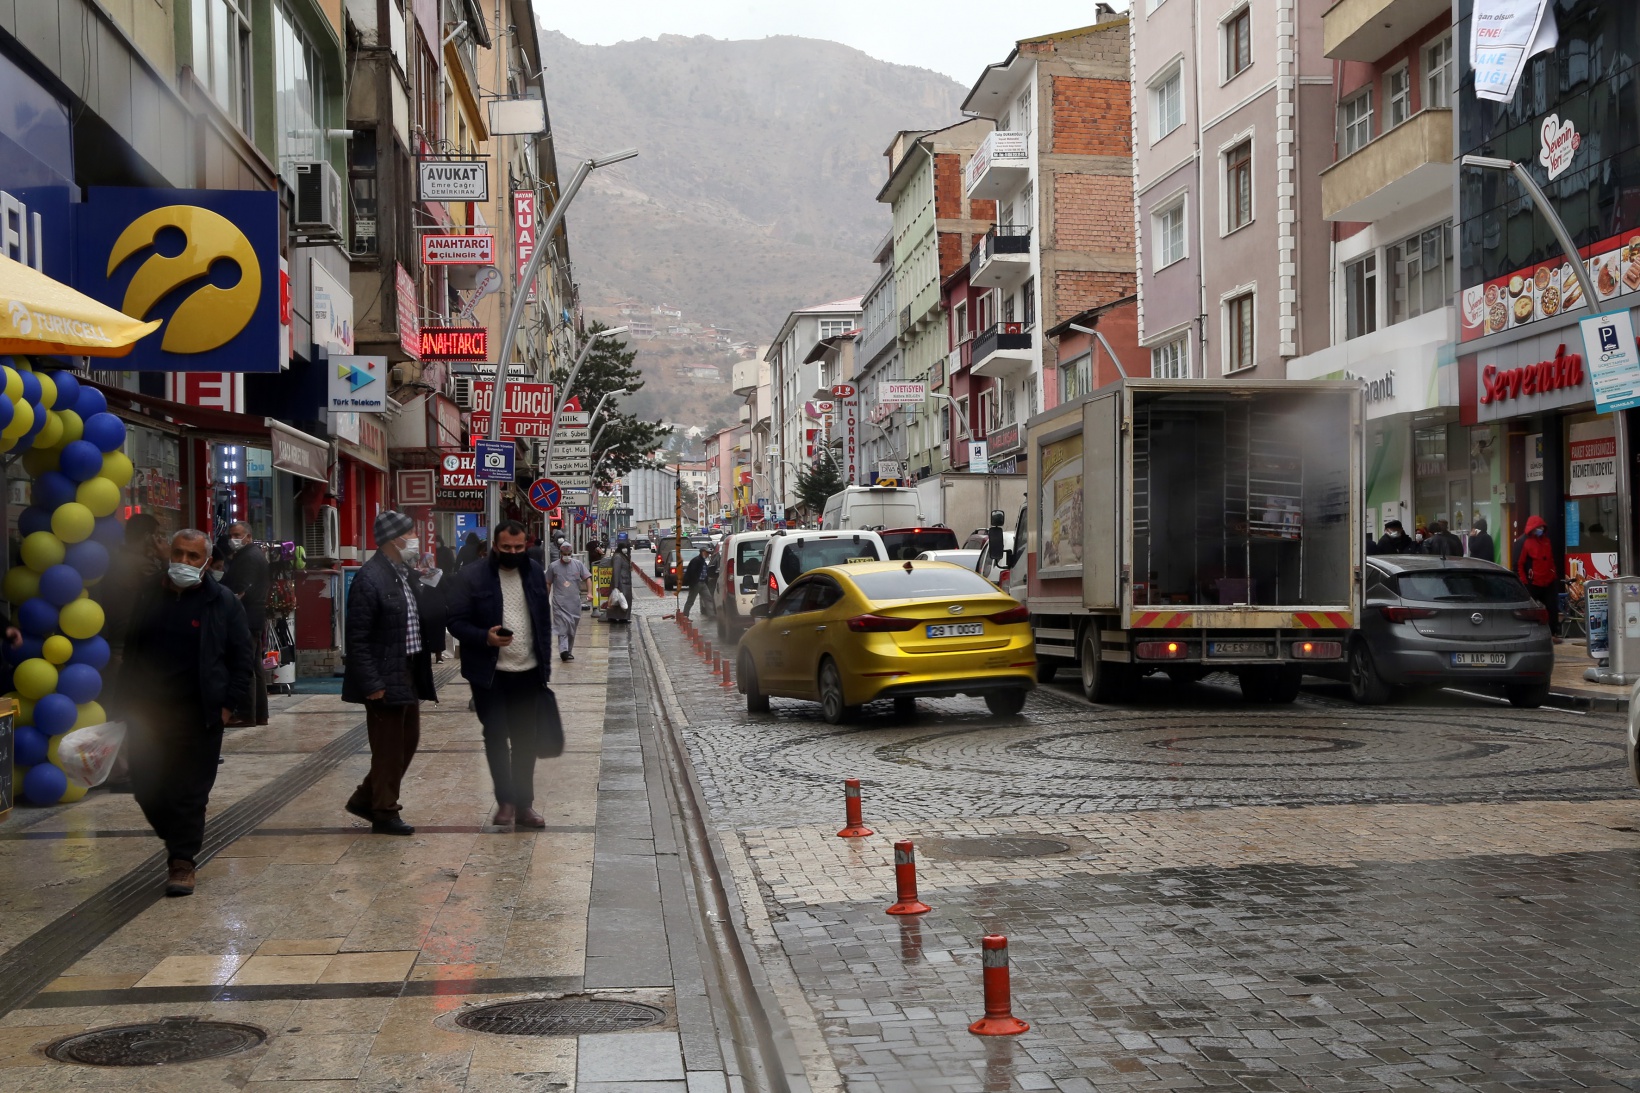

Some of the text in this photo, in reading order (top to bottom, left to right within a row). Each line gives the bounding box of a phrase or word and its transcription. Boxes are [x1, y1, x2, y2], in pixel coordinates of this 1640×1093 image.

[1477, 53, 1506, 65] ANE
[427, 168, 478, 180] AVUKAT
[428, 239, 489, 249] ANAHTARCI
[517, 200, 535, 292] KUAFÖ
[439, 250, 477, 259] ÇİLİNGİR
[1602, 328, 1613, 342] P
[421, 333, 485, 354] ANAHTARCI
[1362, 370, 1394, 401] aranti
[473, 385, 552, 417] GÖLÜKÇÜ
[473, 418, 511, 434] YÜEL
[515, 420, 551, 436] OPTİK
[847, 409, 855, 485] LOKANTAS
[1571, 446, 1585, 458] PAKET
[459, 489, 484, 498] OPTİK
[931, 624, 983, 637] 29 T 0037
[1456, 653, 1505, 663] 61 AAC 002
